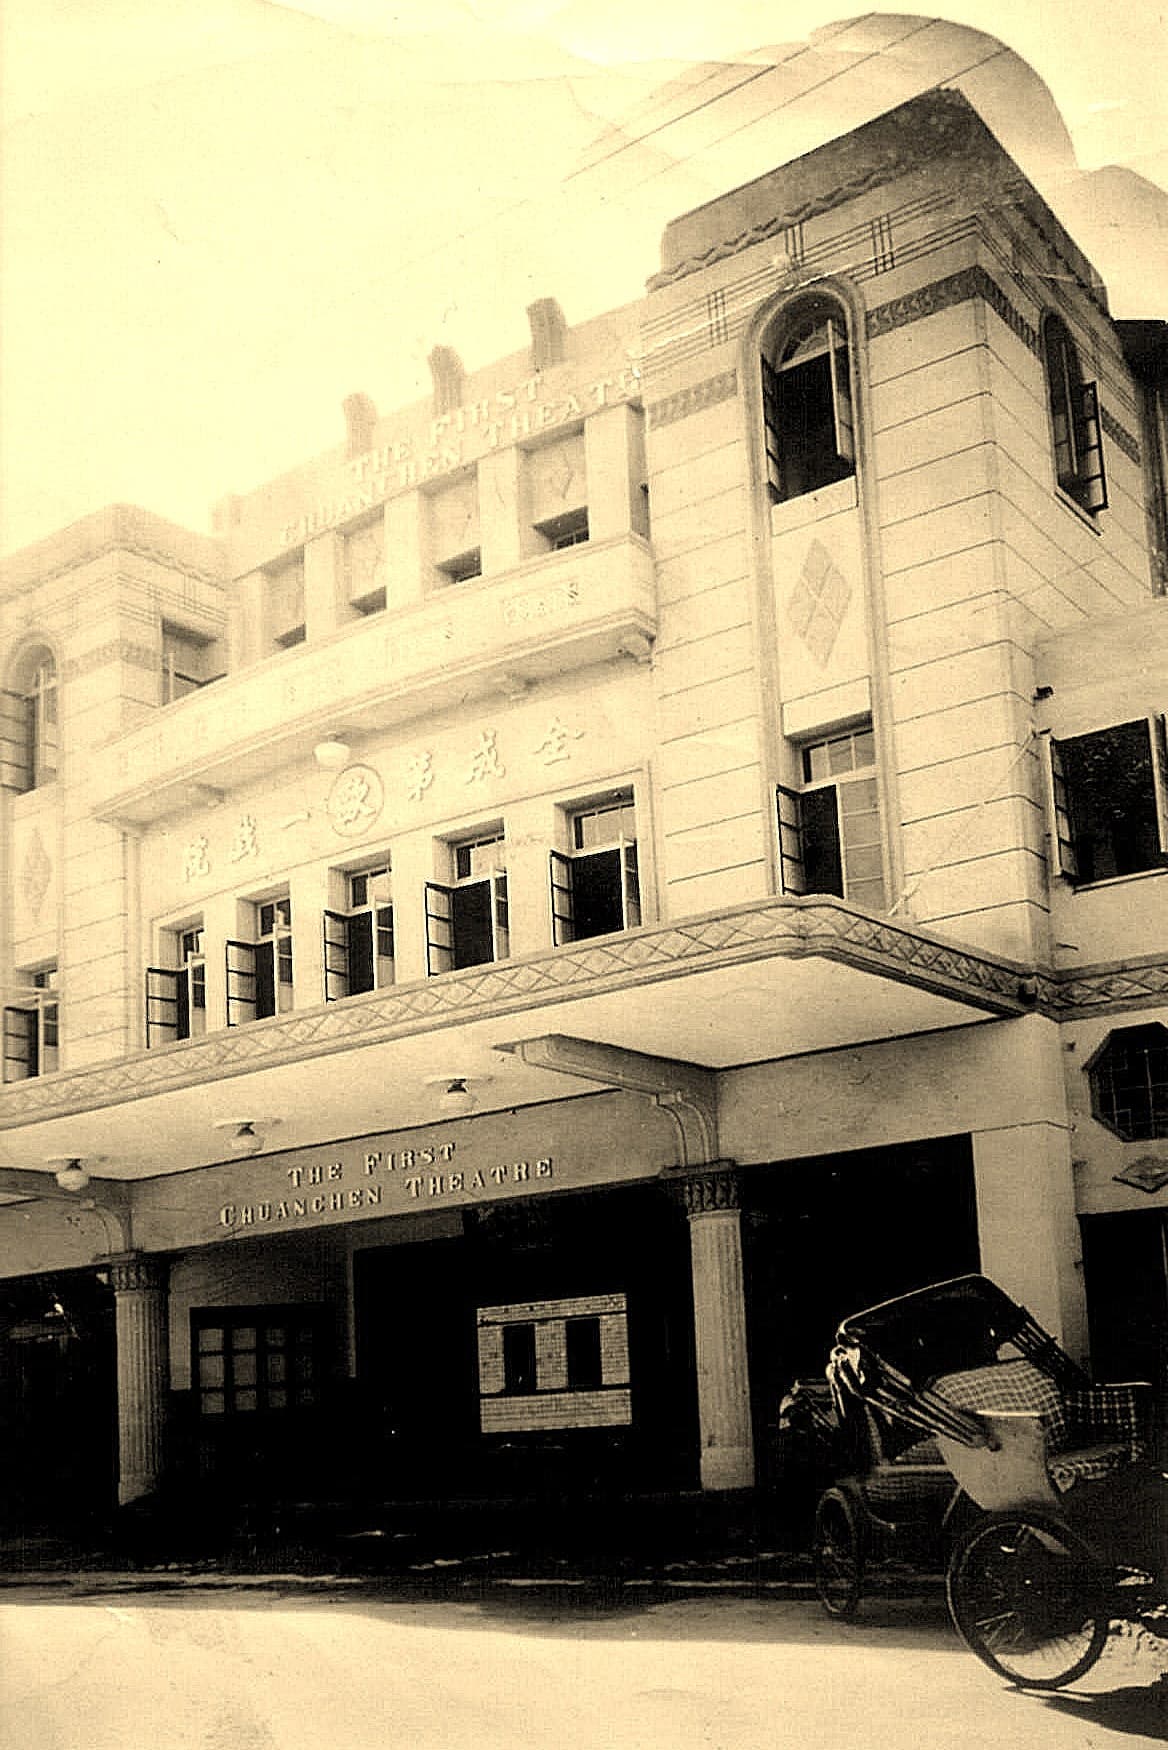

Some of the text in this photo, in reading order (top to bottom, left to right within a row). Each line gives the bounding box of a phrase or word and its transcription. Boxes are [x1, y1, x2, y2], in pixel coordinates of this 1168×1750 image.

[350, 375, 544, 480] THE FIRST
[218, 1157, 554, 1228] CHUANCHEN THEATRE
[287, 1142, 457, 1188] THE FIRST
